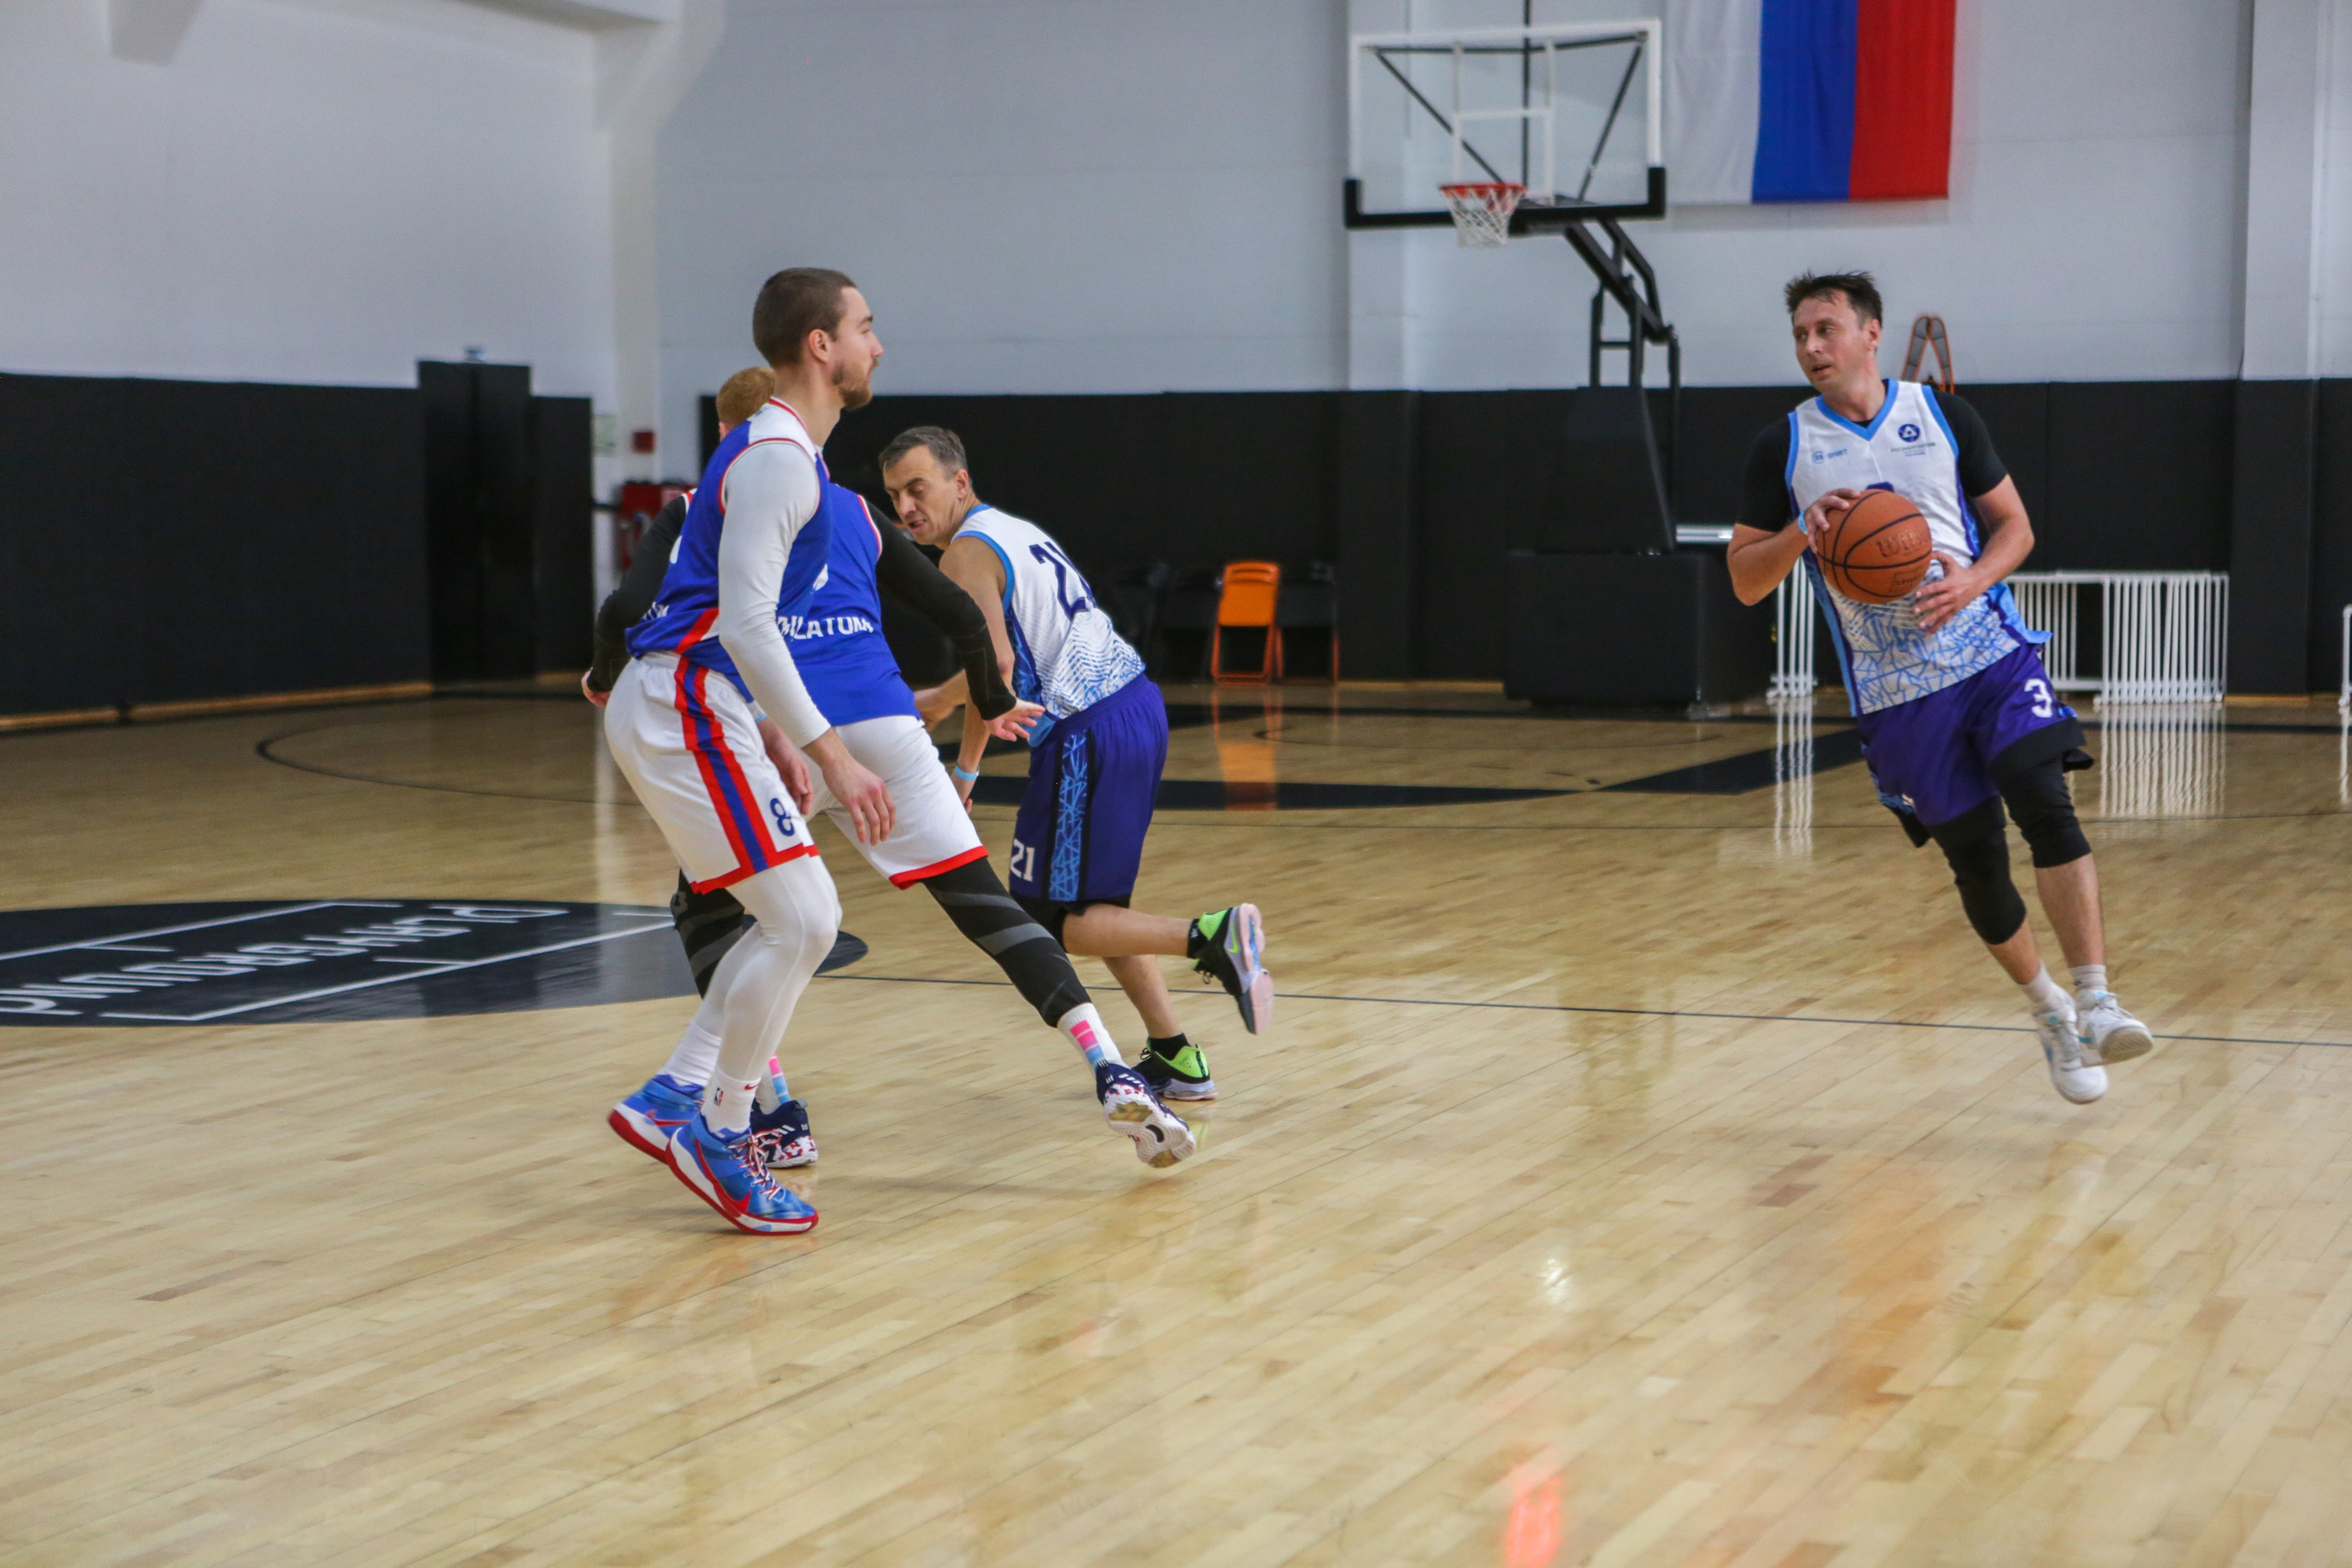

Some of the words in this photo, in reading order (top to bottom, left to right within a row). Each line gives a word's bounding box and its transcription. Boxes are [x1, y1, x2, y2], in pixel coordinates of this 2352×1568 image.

[2024, 678, 2053, 718] 3
[769, 797, 796, 838] 8
[1010, 838, 1035, 883] 21
